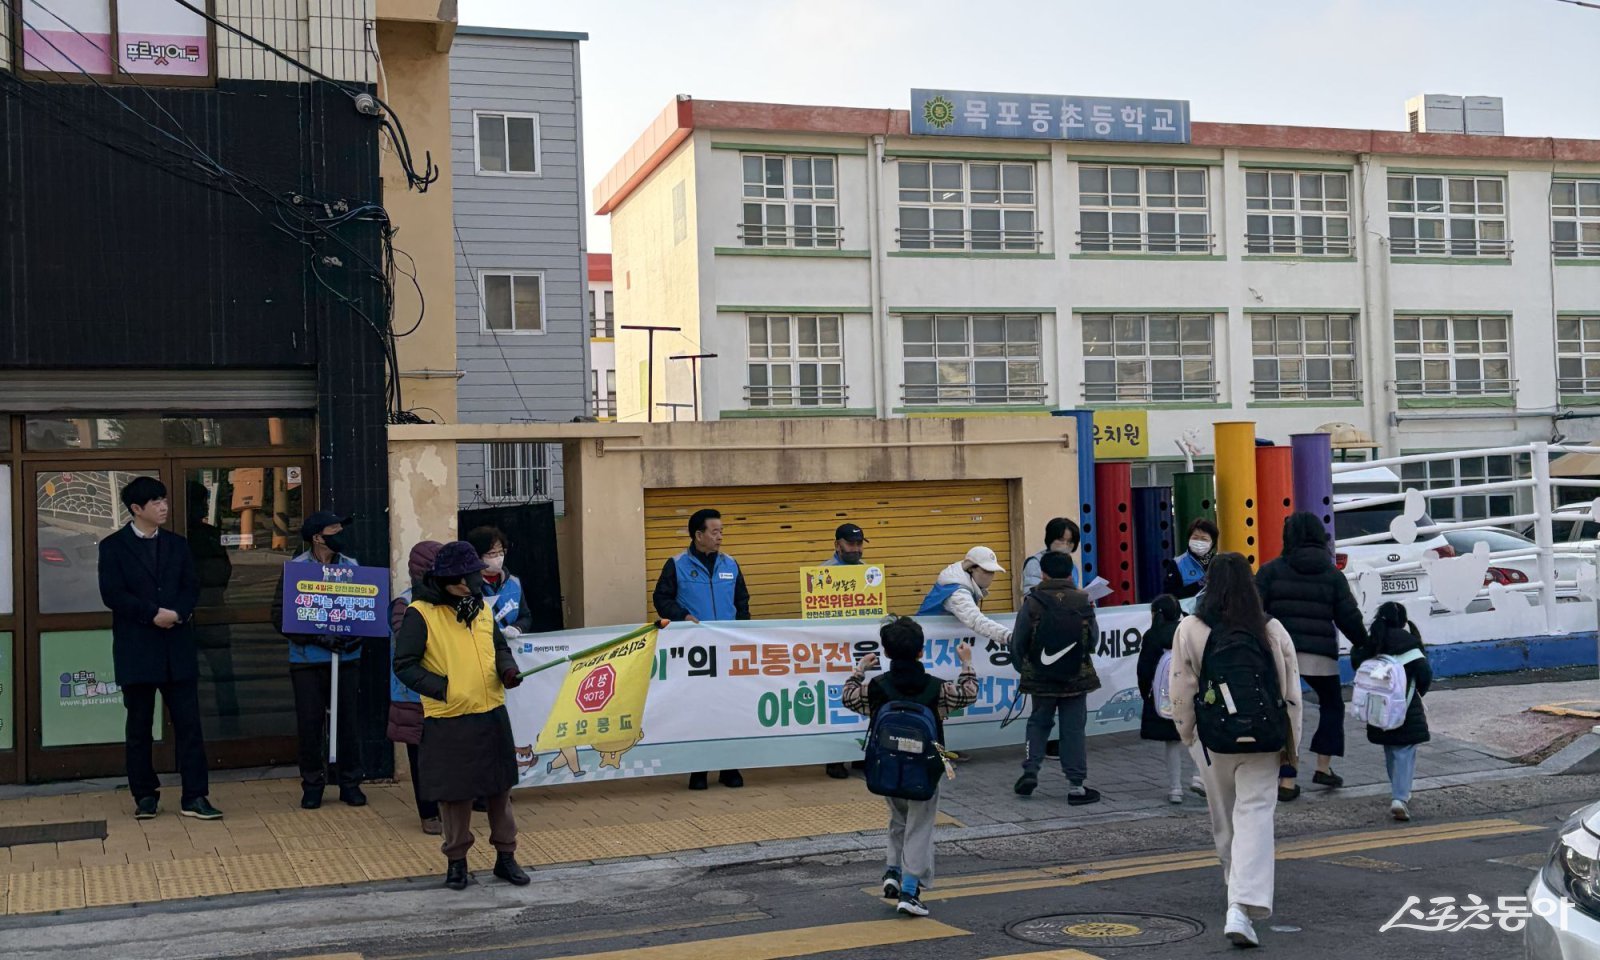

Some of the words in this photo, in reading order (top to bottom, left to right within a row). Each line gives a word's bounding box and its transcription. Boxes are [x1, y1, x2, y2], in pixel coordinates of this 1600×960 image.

[127, 41, 199, 65] 푸르넷에듀
[963, 99, 1177, 135] 목포동초등학교
[334, 596, 375, 609] 사람에게
[805, 592, 883, 610] 안전위협요소!
[297, 607, 328, 621] 안전을
[845, 609, 858, 617] 신고
[728, 640, 883, 677] 교통안전을
